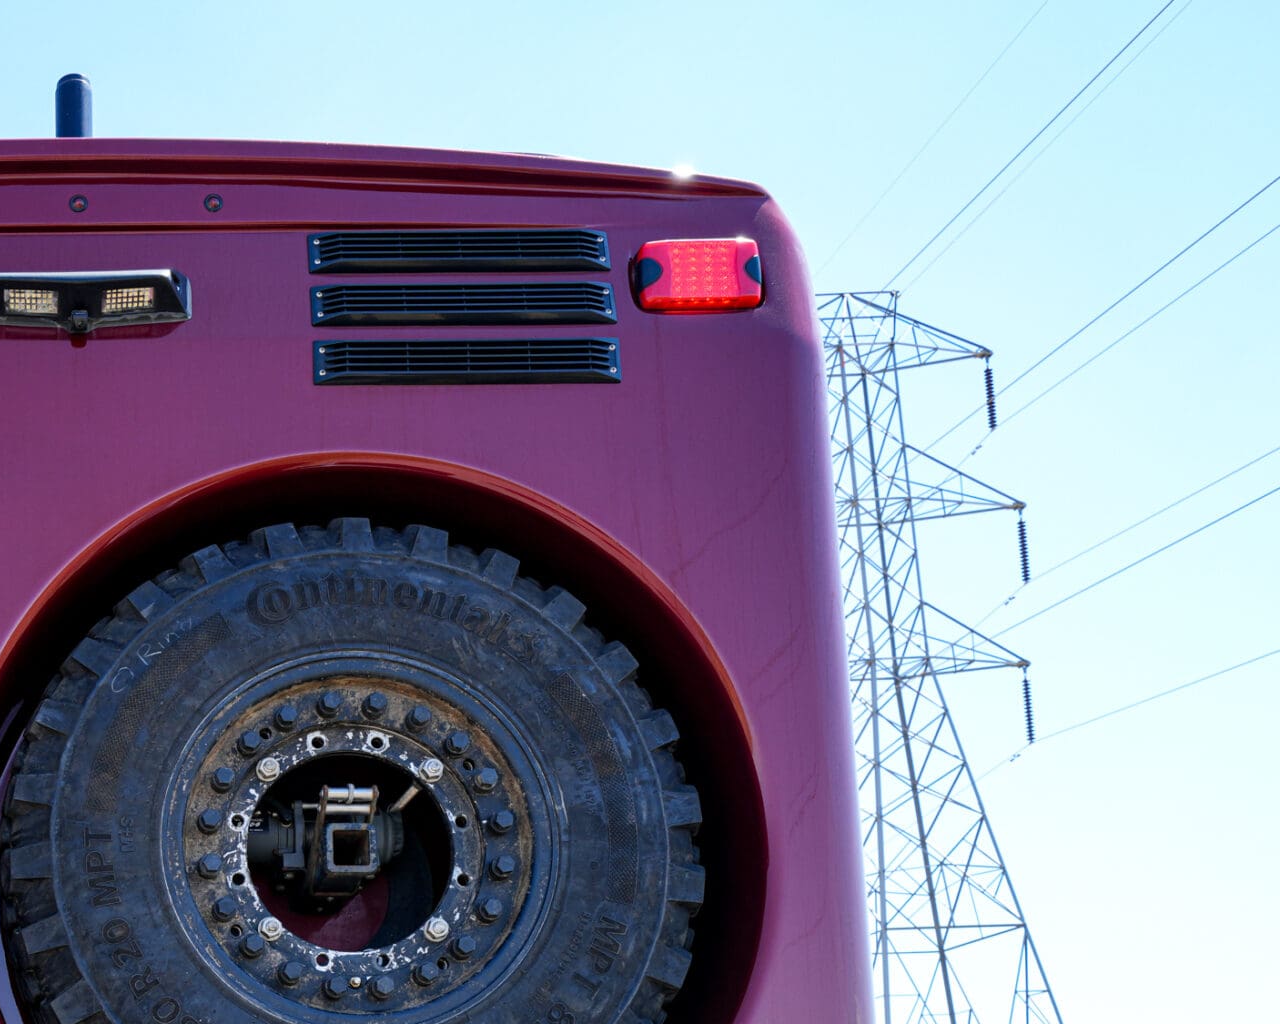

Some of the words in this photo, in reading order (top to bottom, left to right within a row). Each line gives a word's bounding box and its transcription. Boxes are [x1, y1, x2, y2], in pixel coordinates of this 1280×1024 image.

[246, 571, 514, 645] Continental
[82, 827, 122, 908] MPT
[571, 914, 629, 1000] MPT
